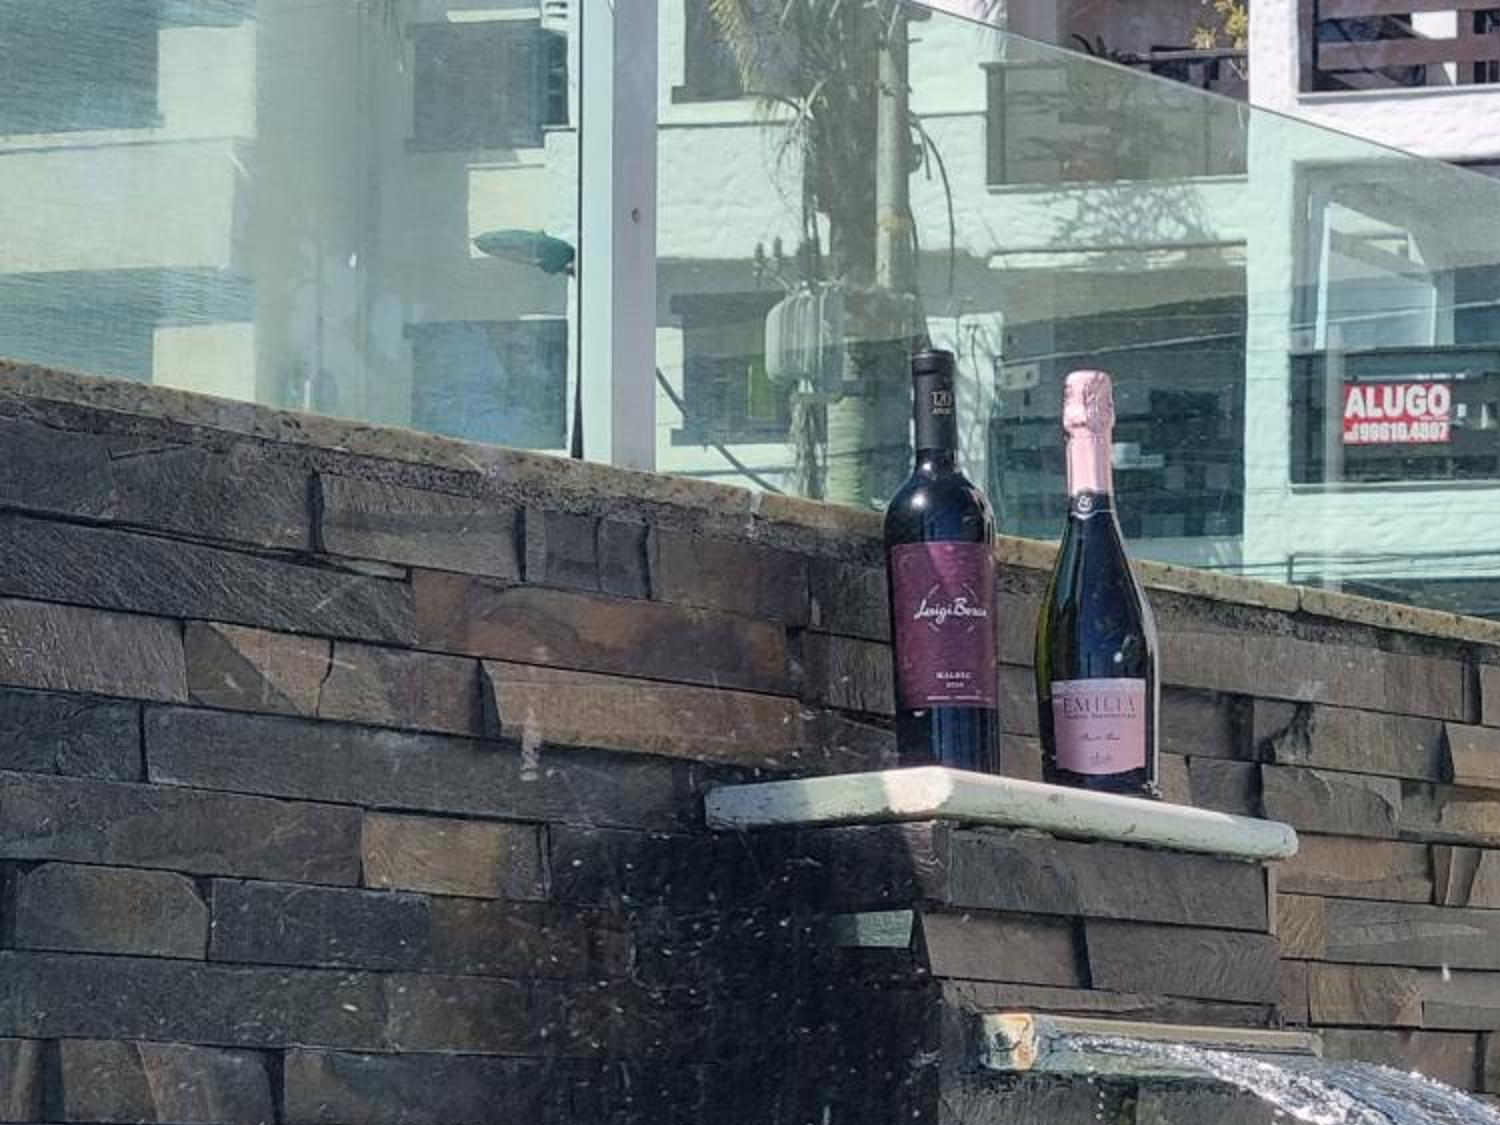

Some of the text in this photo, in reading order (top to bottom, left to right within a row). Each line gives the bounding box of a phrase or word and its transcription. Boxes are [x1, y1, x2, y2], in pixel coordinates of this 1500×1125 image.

[1343, 384, 1451, 418] ALUGO
[913, 598, 953, 625] Luigi
[1063, 695, 1135, 714] EMILIA
